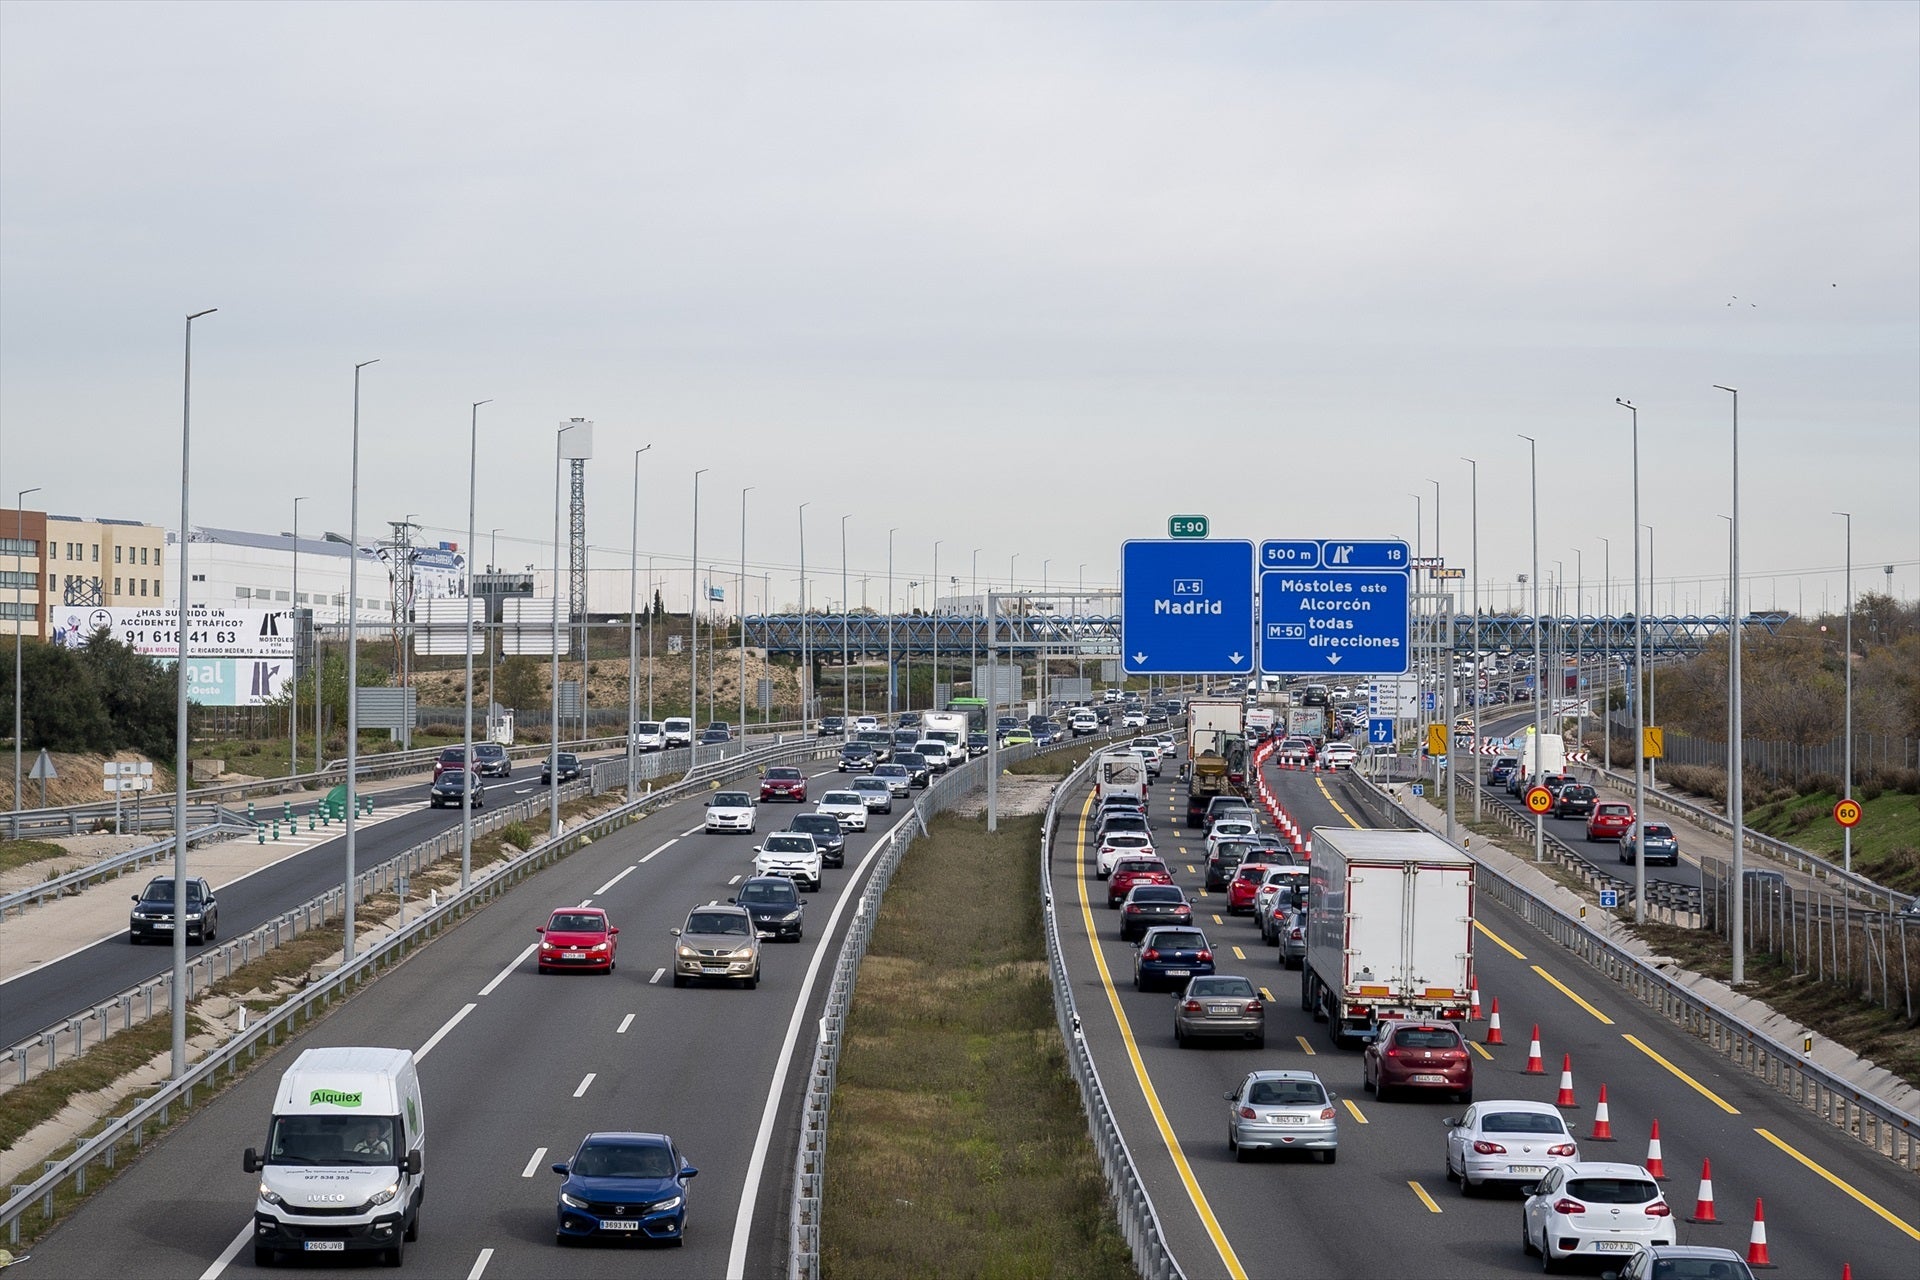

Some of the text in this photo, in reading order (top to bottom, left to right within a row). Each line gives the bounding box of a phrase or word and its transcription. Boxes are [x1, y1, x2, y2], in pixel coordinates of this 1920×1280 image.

[1173, 522, 1204, 532] E-90
[1268, 549, 1311, 560] 500 m
[1387, 550, 1401, 560] 18
[1433, 569, 1464, 578] IKEA
[1176, 582, 1200, 592] A-5
[1281, 579, 1388, 593] Móstoles este
[1154, 599, 1222, 614] Madrid
[1299, 597, 1371, 611] Alcorcón
[136, 609, 161, 618] ¿HAS
[165, 610, 208, 618] SURIDO
[283, 611, 295, 619] 18
[120, 619, 177, 627] ACCIDENTE
[196, 618, 244, 627] TRÁFICO?
[1308, 616, 1354, 629] todas
[1269, 626, 1303, 636] M-50
[125, 630, 236, 643] 91 618 41 63
[1308, 634, 1401, 647] direcciones
[1532, 796, 1547, 805] 60
[1840, 808, 1856, 818] 60
[1605, 897, 1612, 905] 6
[312, 1091, 361, 1104] Alquiex
[307, 1194, 345, 1202] IVECO
[605, 1221, 622, 1229] 3693
[309, 1242, 328, 1250] 2605
[1601, 1242, 1619, 1250] 3707
